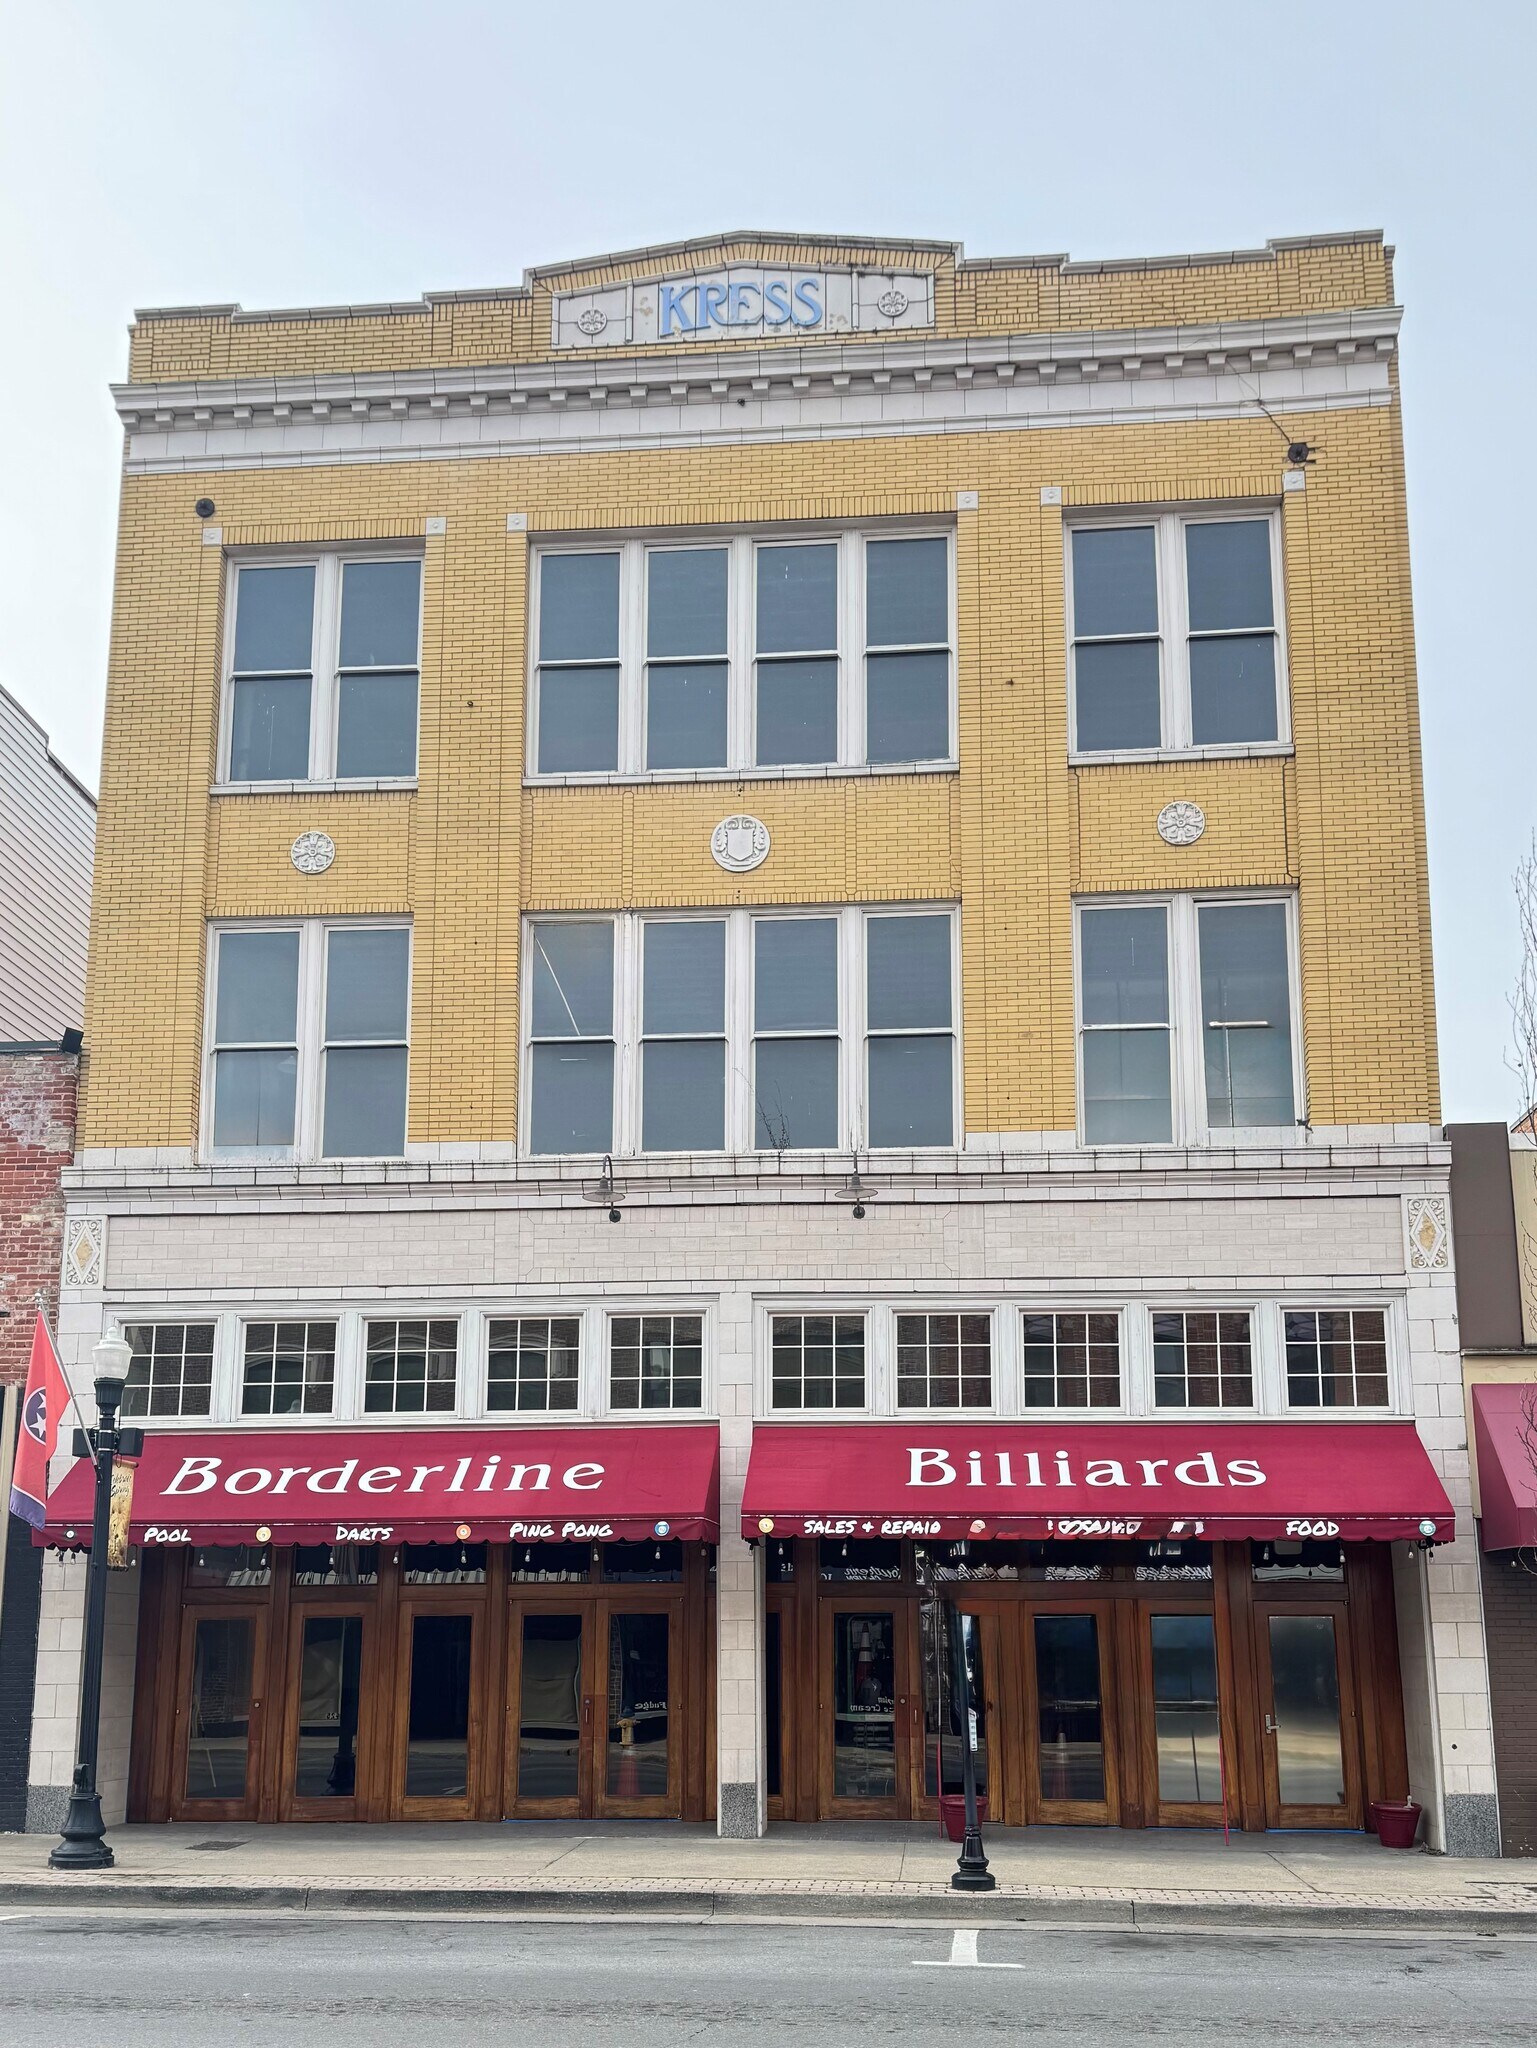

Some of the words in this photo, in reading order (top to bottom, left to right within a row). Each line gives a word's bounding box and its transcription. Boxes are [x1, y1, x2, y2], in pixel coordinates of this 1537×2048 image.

[660, 278, 823, 337] KRESS
[159, 1454, 605, 1495] Borderline
[905, 1447, 1267, 1487] Billiards
[335, 1525, 394, 1541] DARTS
[509, 1522, 555, 1538] PING
[561, 1521, 614, 1538] PONG
[803, 1519, 858, 1534] SALES
[1285, 1520, 1340, 1536] FOOD
[143, 1527, 192, 1543] POOL
